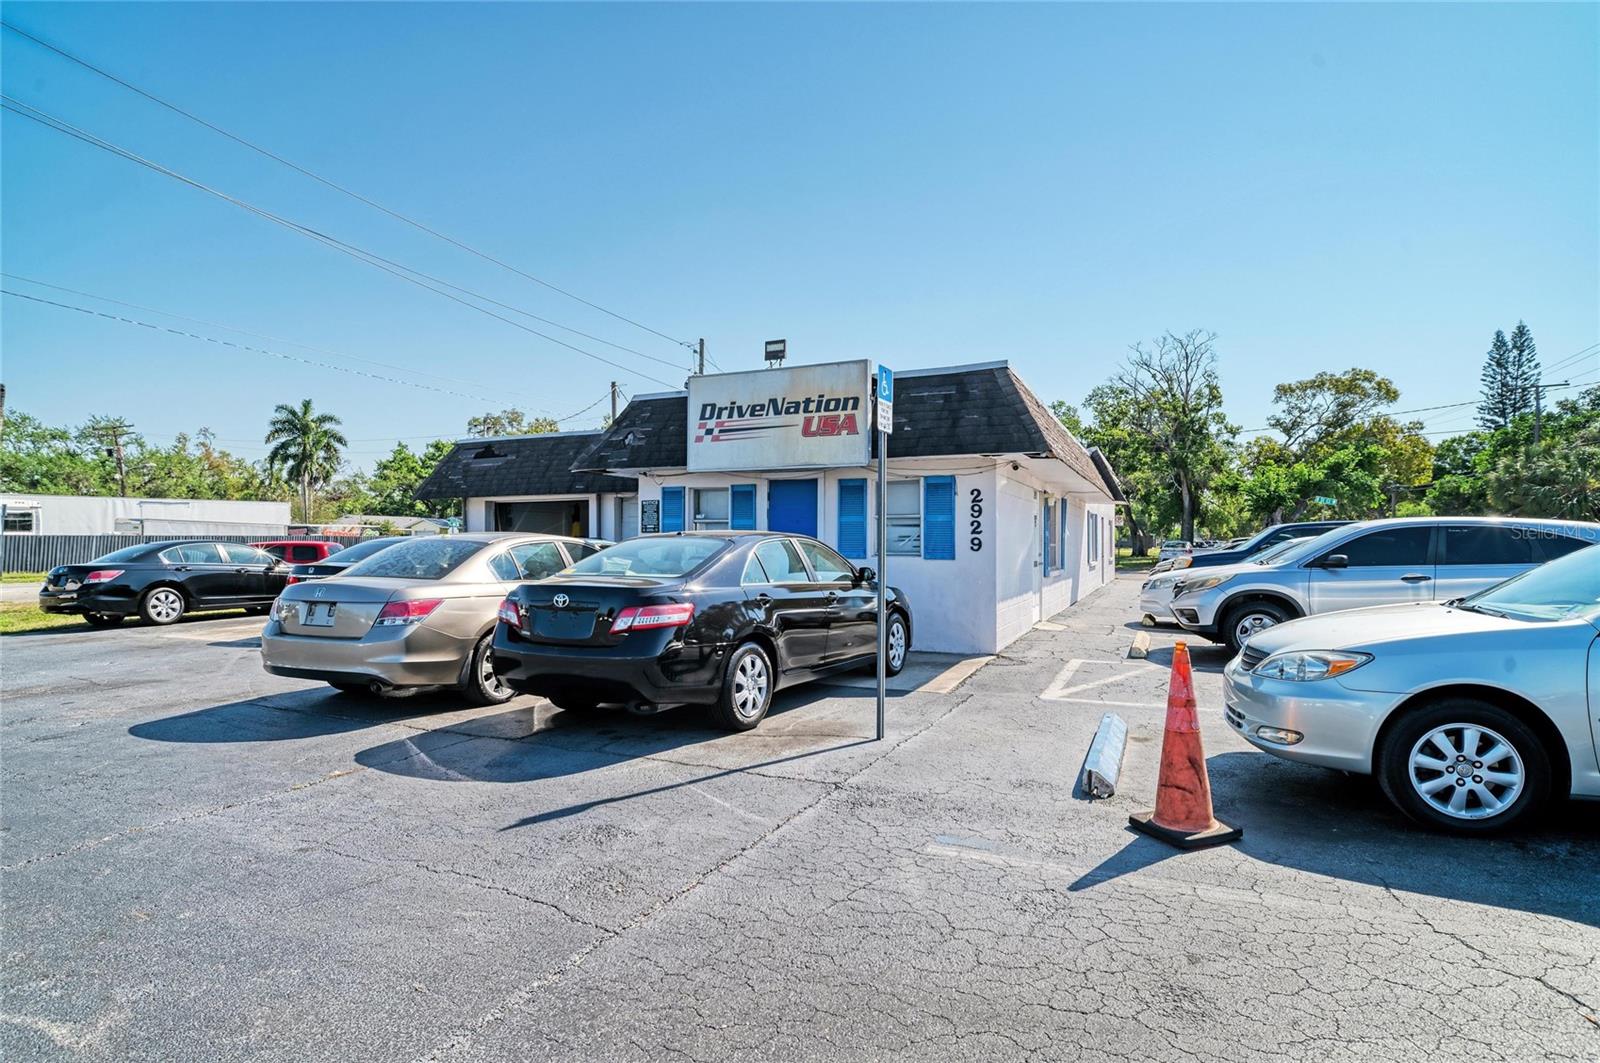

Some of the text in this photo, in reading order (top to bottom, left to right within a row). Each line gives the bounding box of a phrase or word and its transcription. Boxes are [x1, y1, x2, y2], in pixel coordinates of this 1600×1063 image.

[699, 394, 859, 421] DriveNation
[801, 413, 859, 437] USA
[970, 488, 984, 552] 2929
